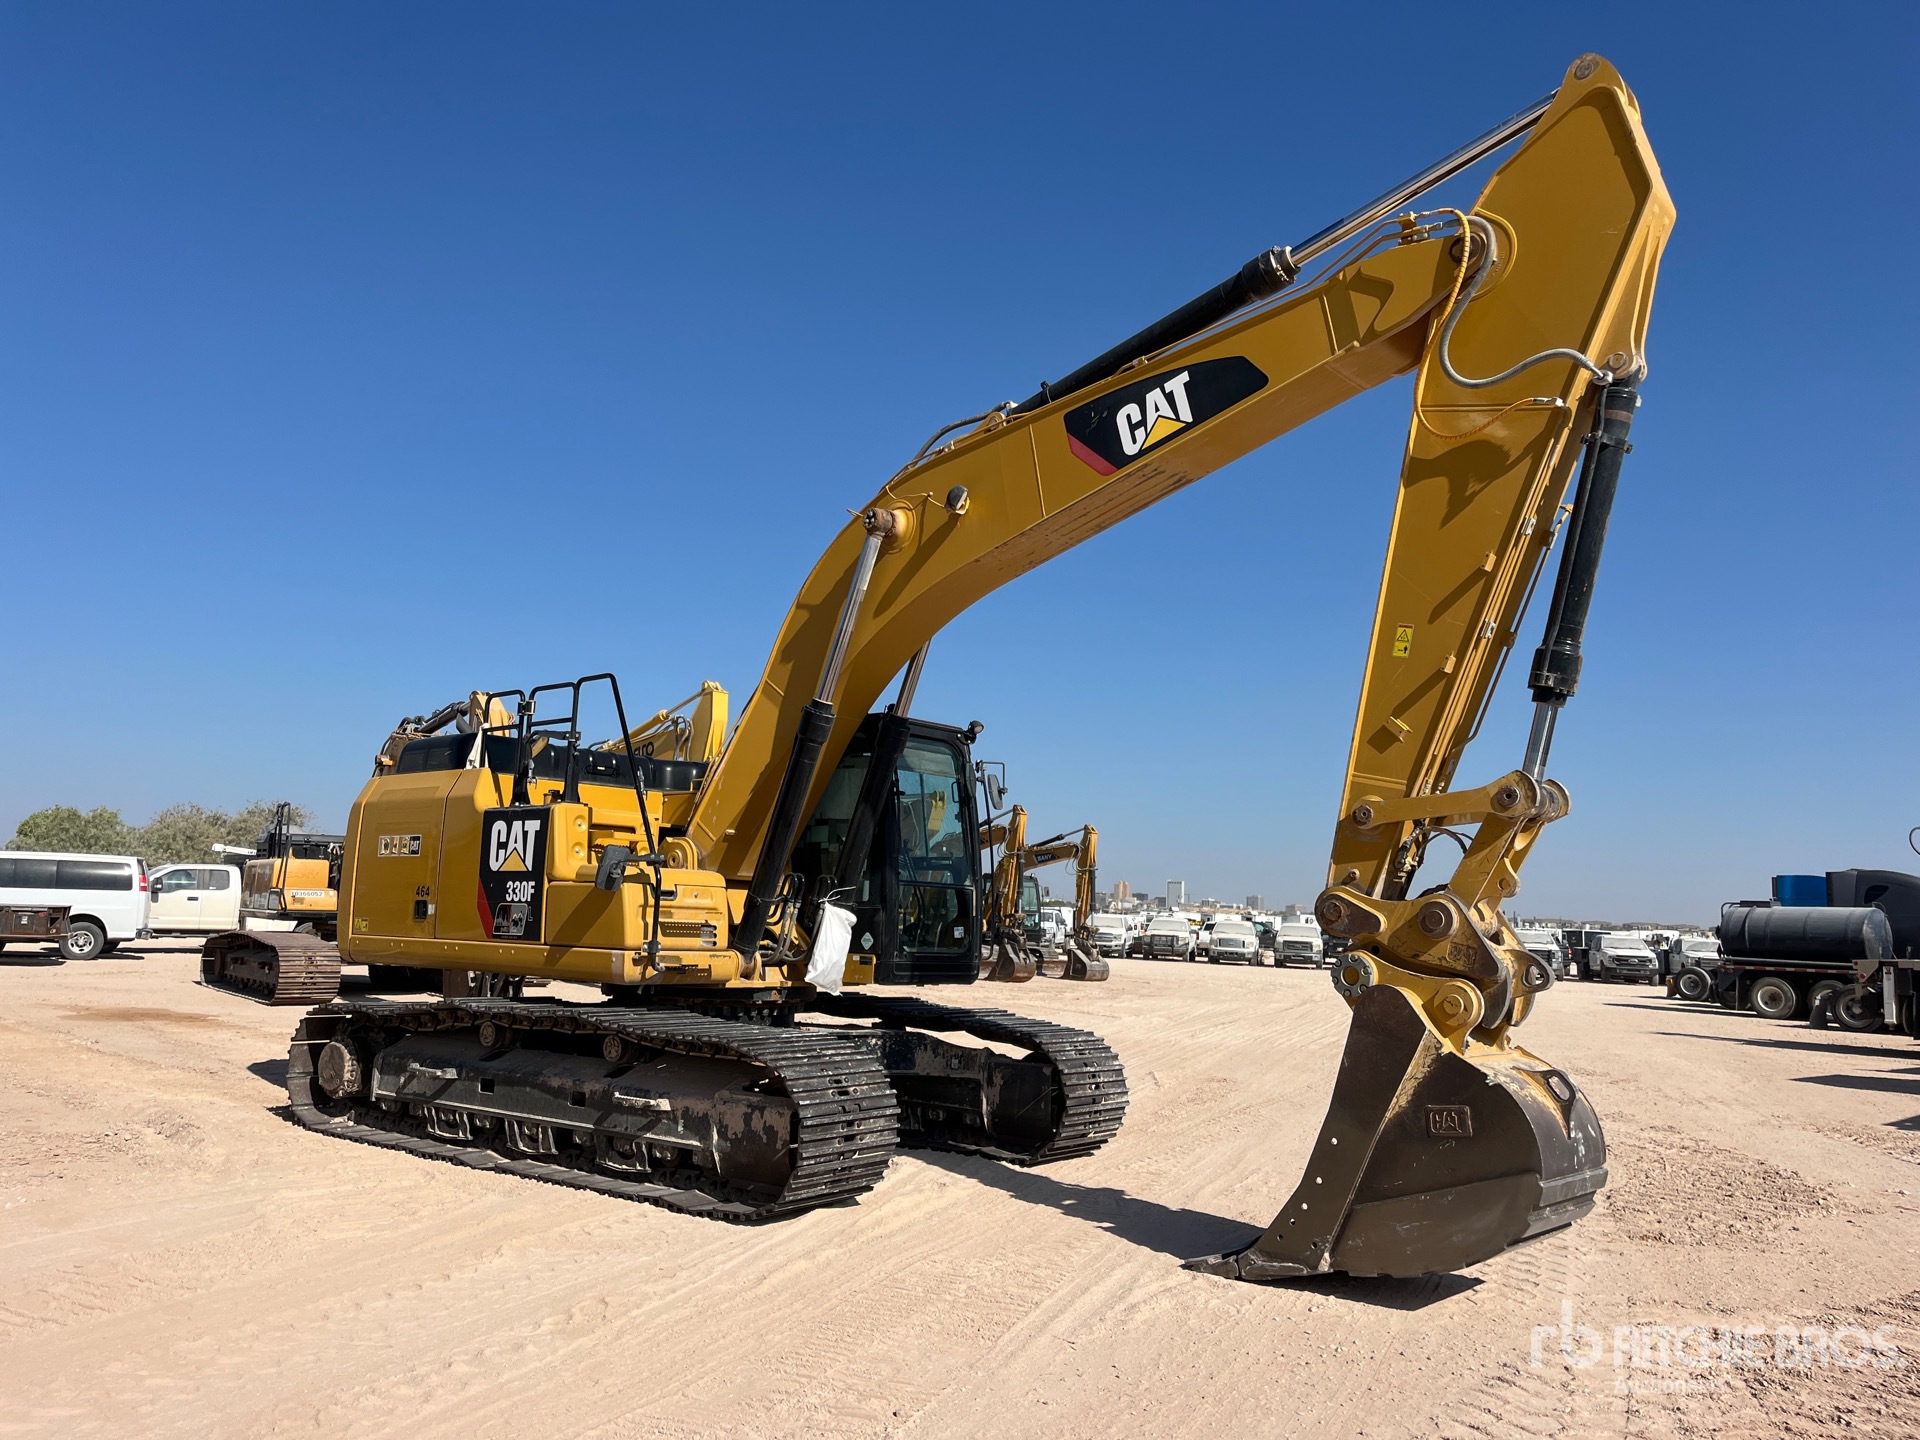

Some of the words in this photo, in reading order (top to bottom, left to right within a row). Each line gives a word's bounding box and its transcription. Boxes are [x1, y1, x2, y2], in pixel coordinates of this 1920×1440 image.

[1116, 370, 1193, 456] CAT
[489, 820, 540, 871] CAT
[415, 885, 430, 898] 464
[506, 881, 535, 902] 330F
[1429, 1111, 1463, 1134] CAT
